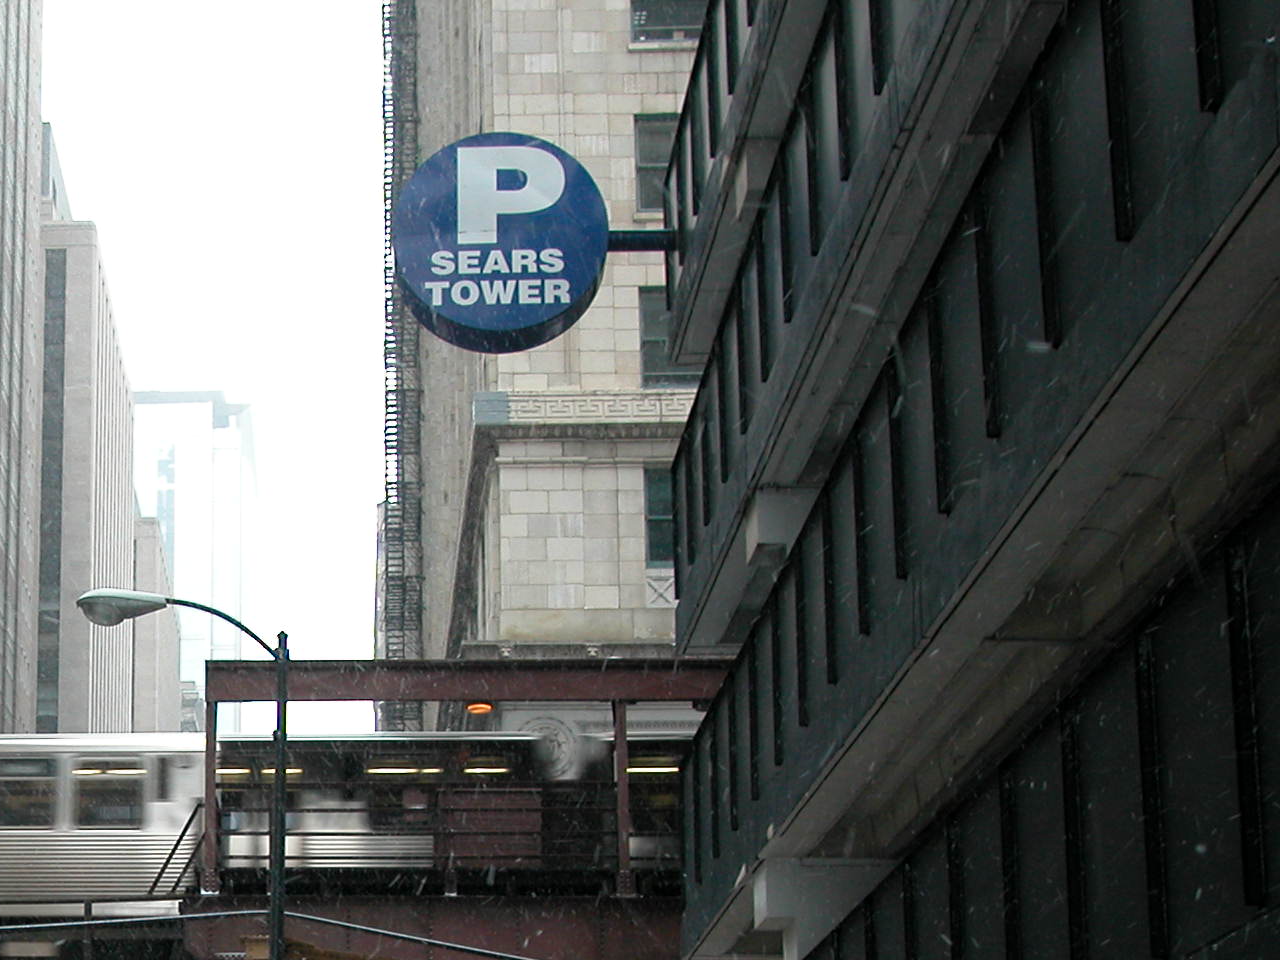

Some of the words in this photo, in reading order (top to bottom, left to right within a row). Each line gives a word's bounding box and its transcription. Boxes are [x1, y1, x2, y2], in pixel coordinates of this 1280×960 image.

[457, 146, 566, 245] P
[431, 249, 565, 275] SEARS
[425, 279, 570, 306] TOWER
